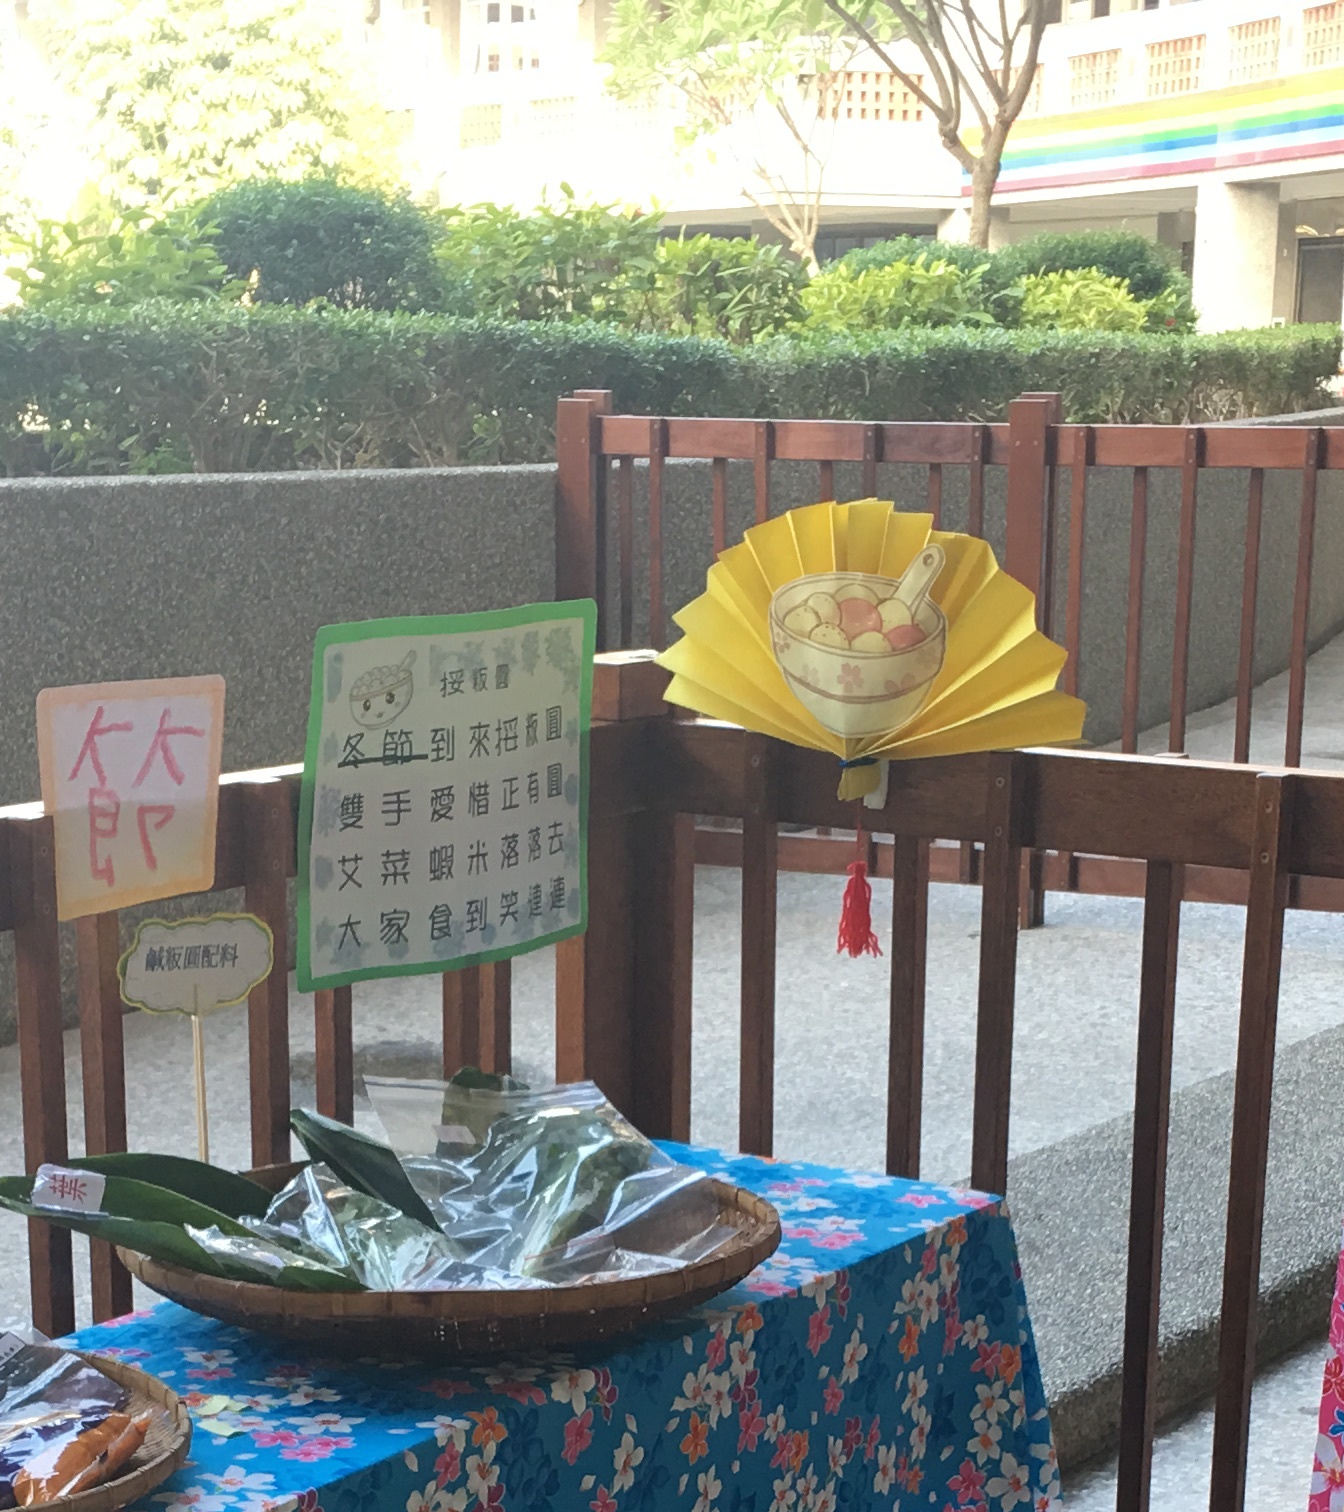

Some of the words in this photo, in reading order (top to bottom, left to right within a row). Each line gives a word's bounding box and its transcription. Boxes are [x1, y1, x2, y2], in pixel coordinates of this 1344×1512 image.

[338, 822, 563, 891] 艾菜蝦米落落去
